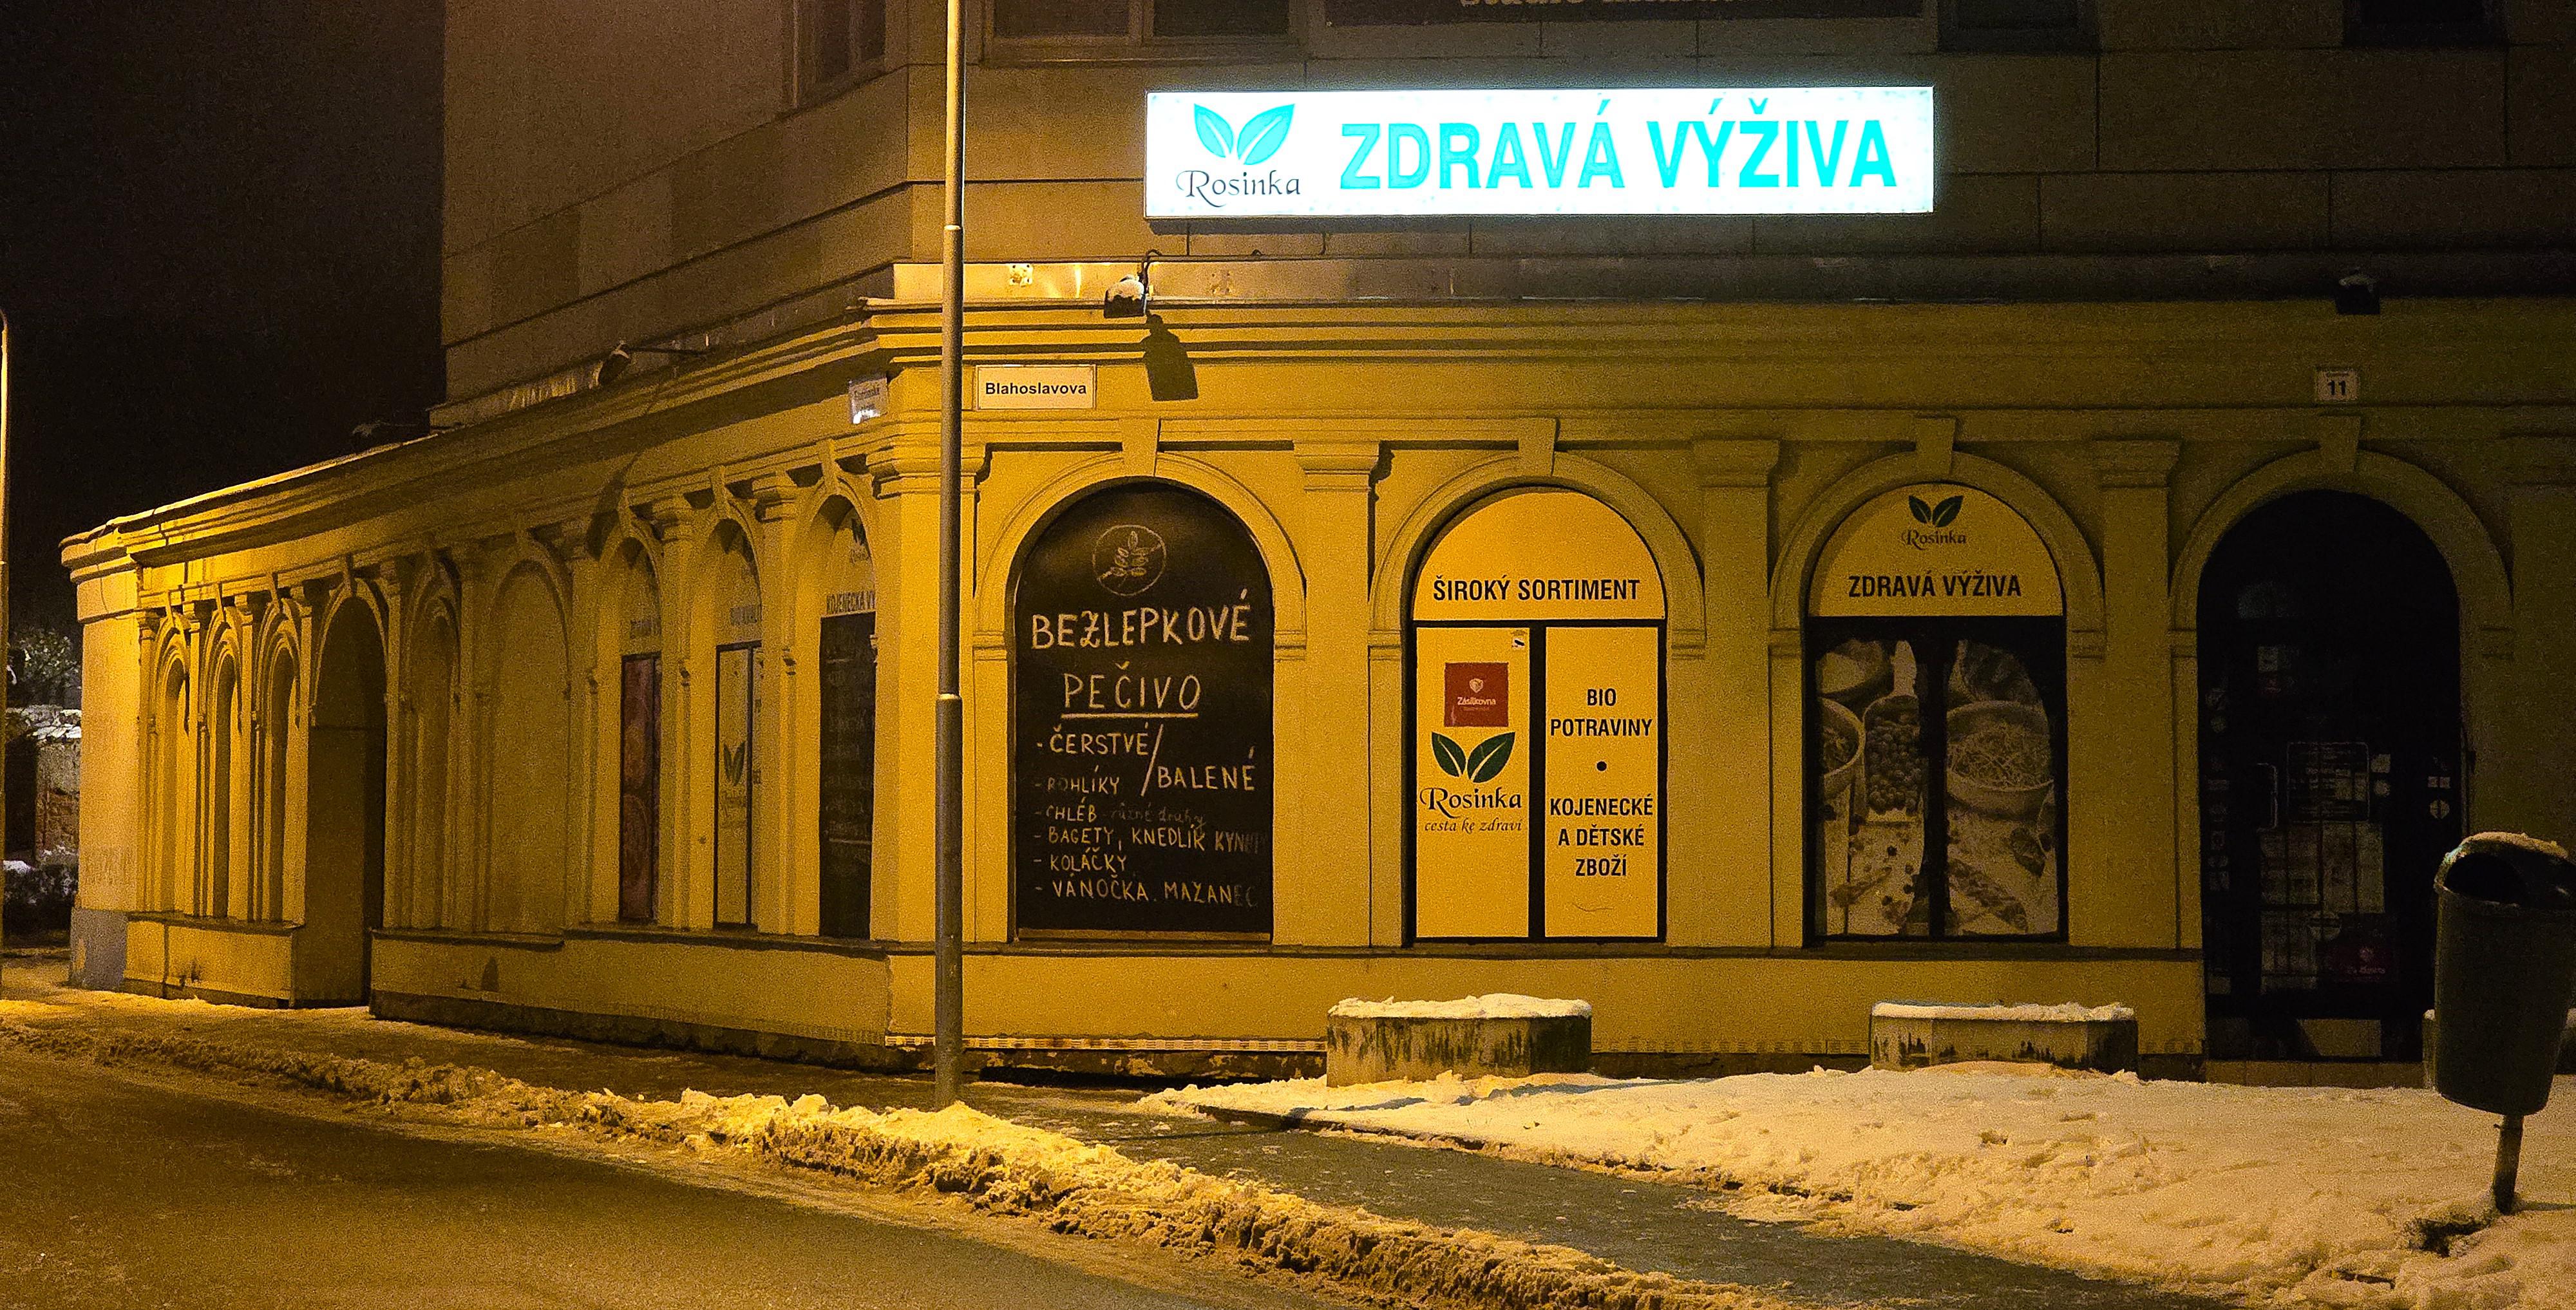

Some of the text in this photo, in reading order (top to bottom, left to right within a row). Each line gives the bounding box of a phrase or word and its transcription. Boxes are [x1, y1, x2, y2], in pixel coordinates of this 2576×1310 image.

[1340, 97, 1897, 189] ZDRAVÁ VÝŽIVA
[1176, 170, 1300, 207] Rosinka
[985, 383, 1086, 395] Blahoslavova
[2327, 380, 2346, 396] 11
[1901, 529, 1966, 550] Rosinka
[1433, 574, 1640, 601] ŠIROKÝ SORTIMENT
[1848, 570, 2022, 598] ZDRAVÁ VÝŽIVA
[1032, 588, 1251, 649] BEZLEPKOVÉ
[1063, 660, 1200, 710] PEČIVO
[1587, 688, 1617, 706] BIO
[1050, 723, 1150, 755] ČERSTVÉ
[1550, 718, 1653, 737] POTRAVINY
[1047, 765, 1120, 795] ROHLÍKY
[1158, 746, 1256, 791] BALENÉ
[1046, 797, 1097, 823] CHLÉB
[1419, 787, 1522, 819] Rosinka
[1550, 793, 1653, 816] KOJENECKÉ
[1132, 824, 1206, 851] KNEDLÍK
[1424, 818, 1522, 834] cesta ke zdraví
[1558, 824, 1644, 846] A DĚTSKÉ
[1050, 847, 1127, 873] KOLÁČKY
[1575, 853, 1627, 877] ZBOŽÍ
